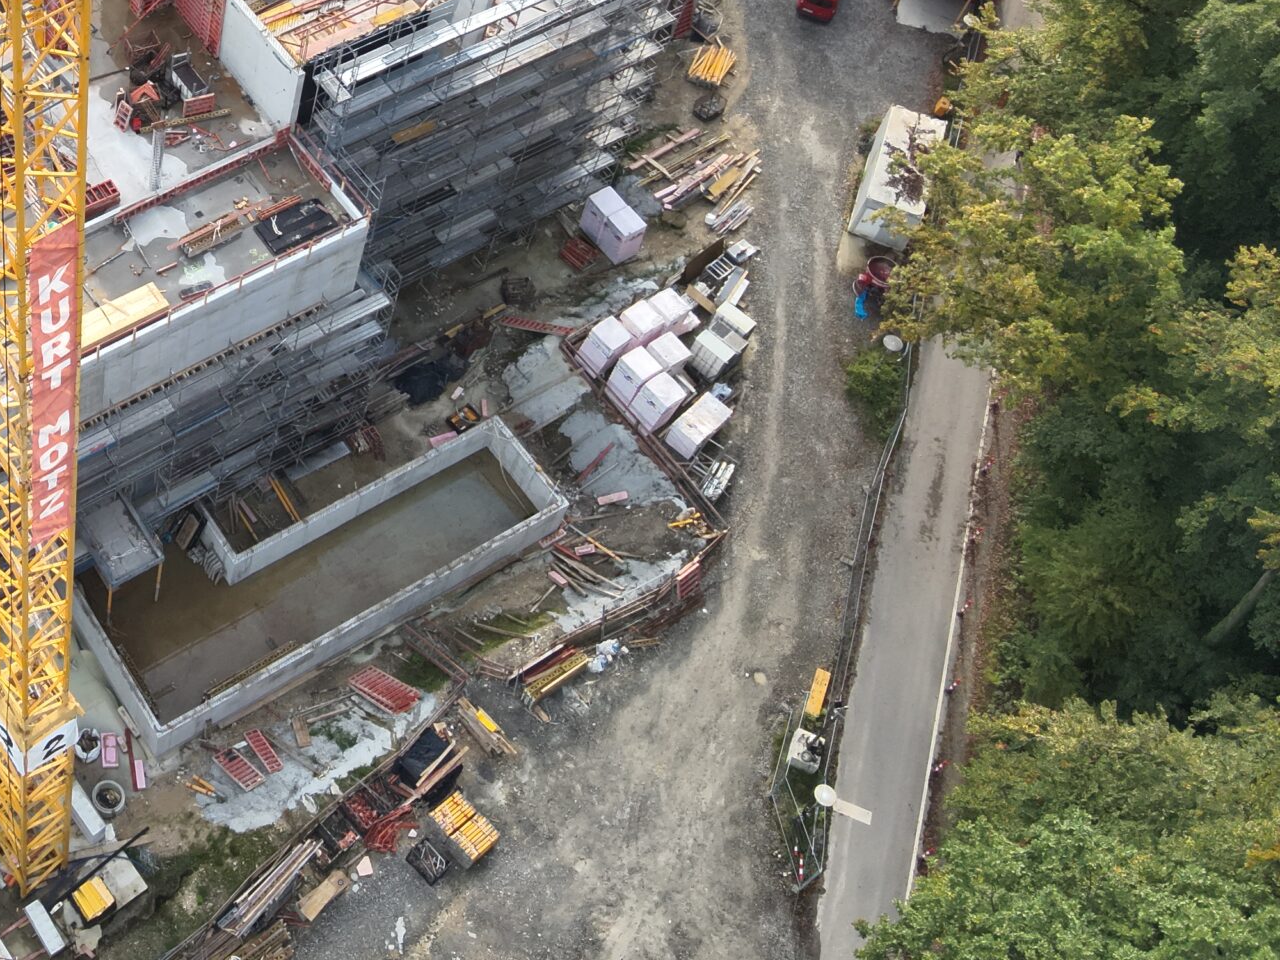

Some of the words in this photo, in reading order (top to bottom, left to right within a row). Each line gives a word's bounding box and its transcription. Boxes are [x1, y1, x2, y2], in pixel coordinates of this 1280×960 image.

[37, 262, 71, 390] KURT
[38, 409, 70, 520] MOTZ
[43, 734, 66, 760] 2
